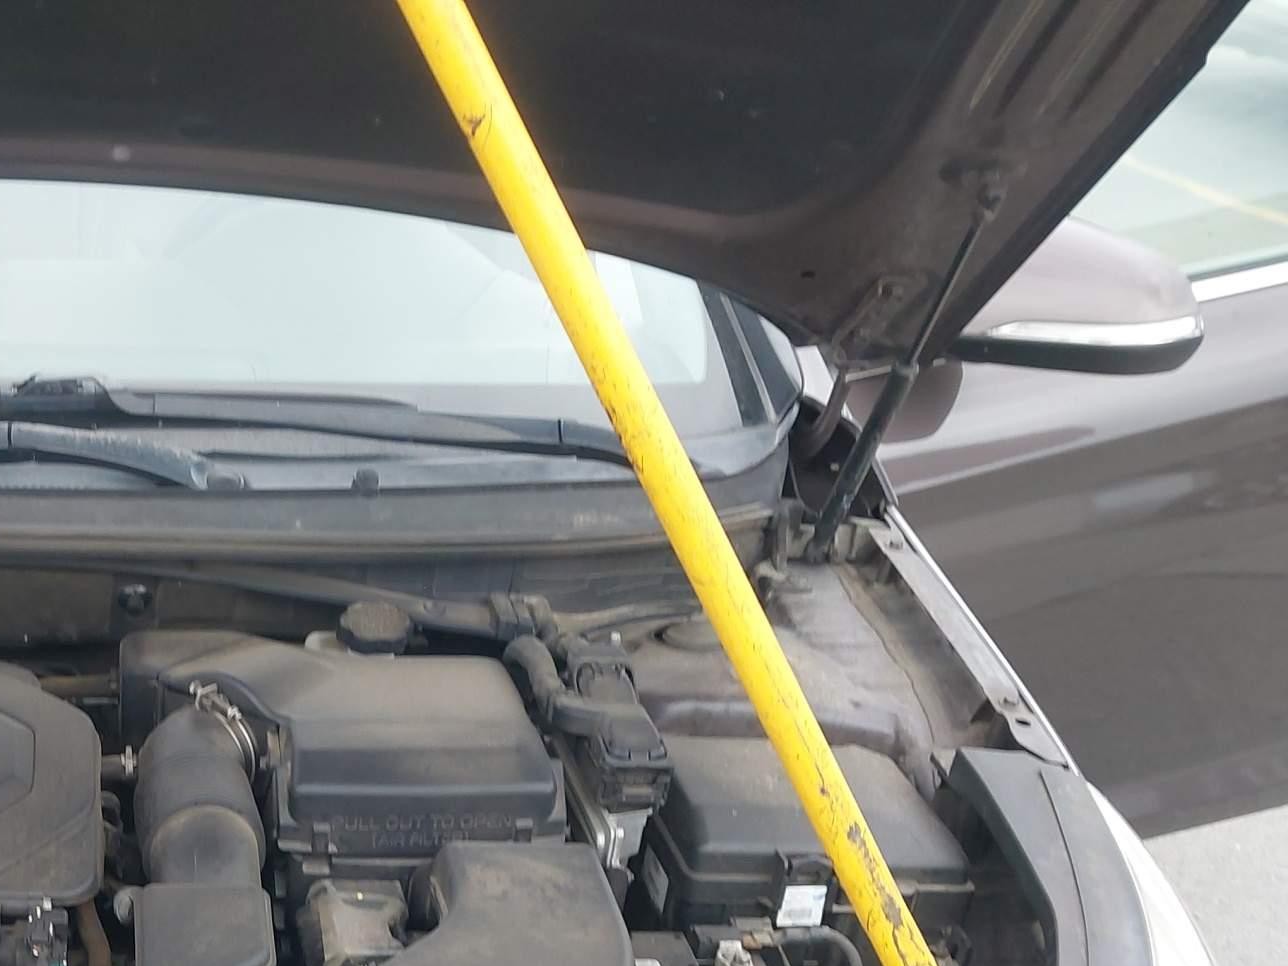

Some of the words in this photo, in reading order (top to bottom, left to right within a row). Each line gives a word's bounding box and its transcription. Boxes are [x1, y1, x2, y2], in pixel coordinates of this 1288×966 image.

[332, 816, 378, 832] PULL
[384, 815, 422, 831] OUT
[429, 814, 456, 829] TO
[459, 813, 512, 829] OPEN
